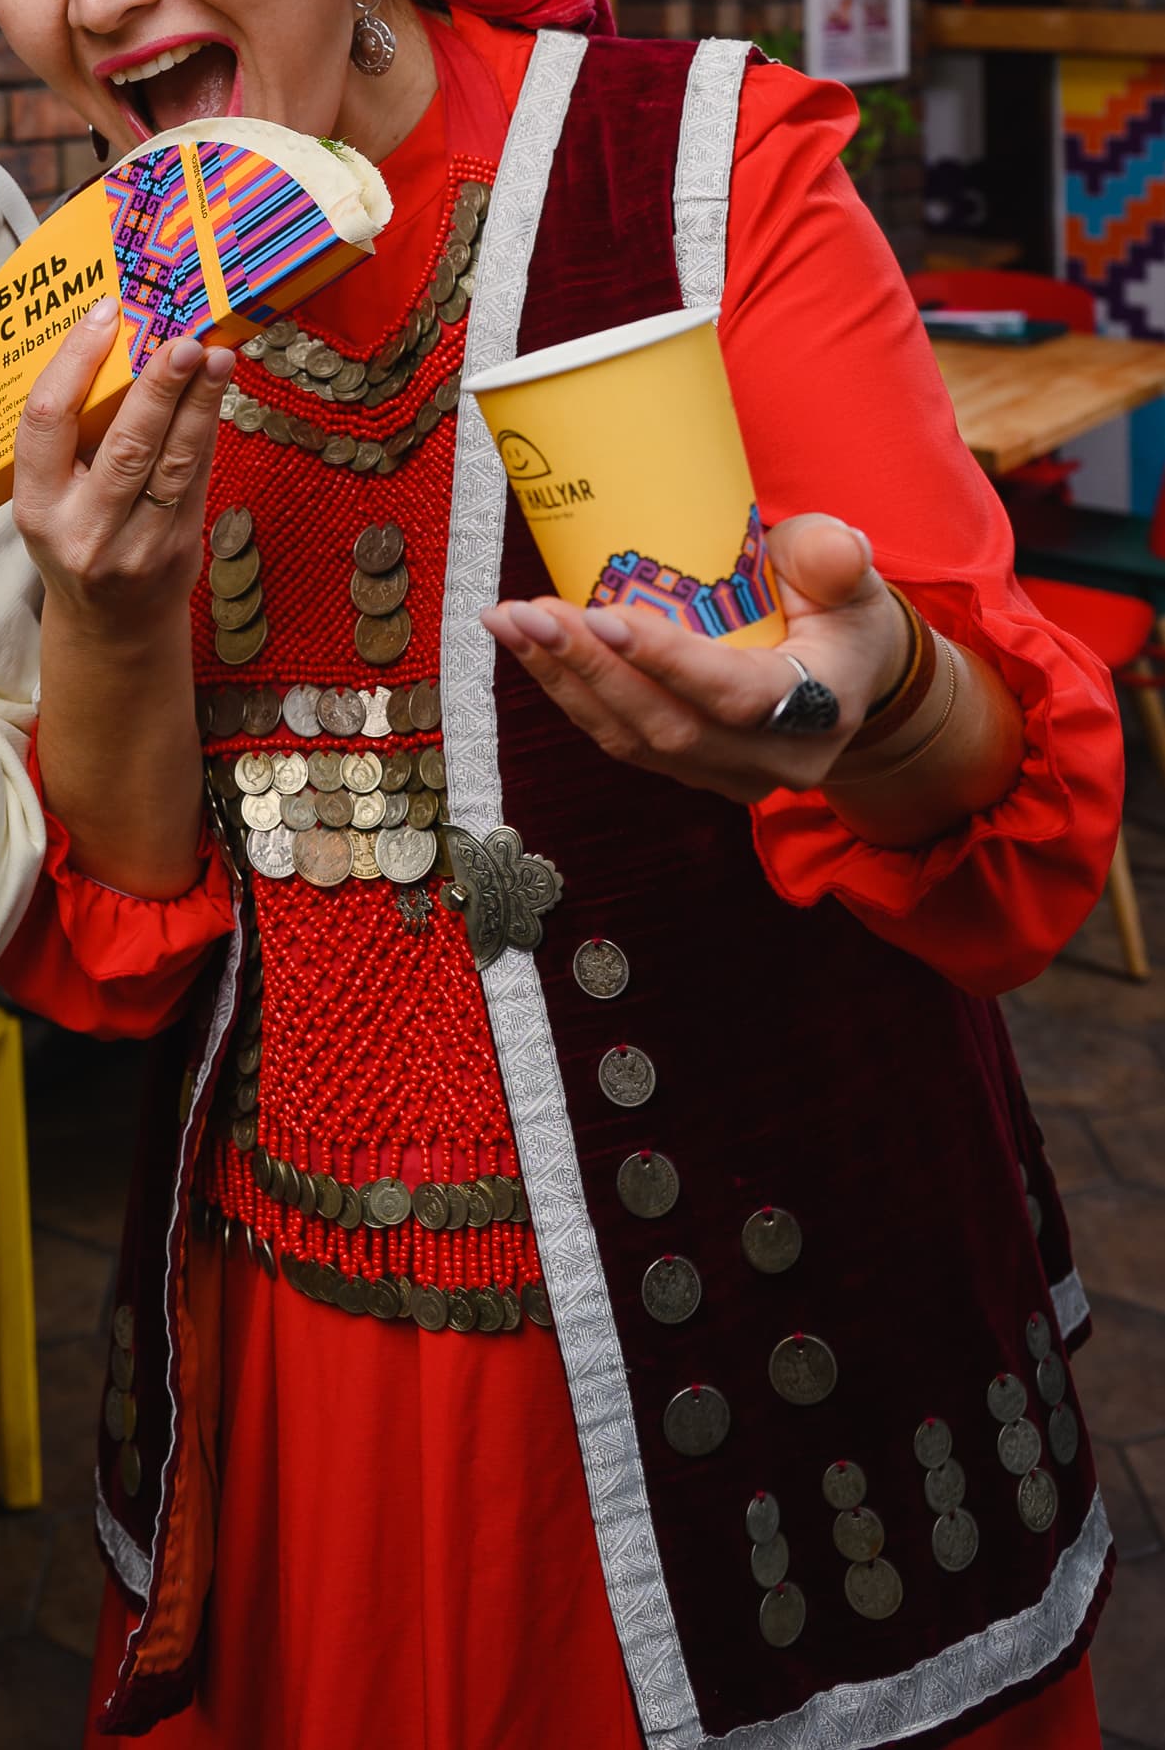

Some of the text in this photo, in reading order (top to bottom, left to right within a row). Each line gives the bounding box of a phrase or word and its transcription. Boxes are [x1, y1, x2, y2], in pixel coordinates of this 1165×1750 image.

[196, 177, 208, 219] ОТРЫВАТЬ
[0, 258, 104, 341] С НАМИ
